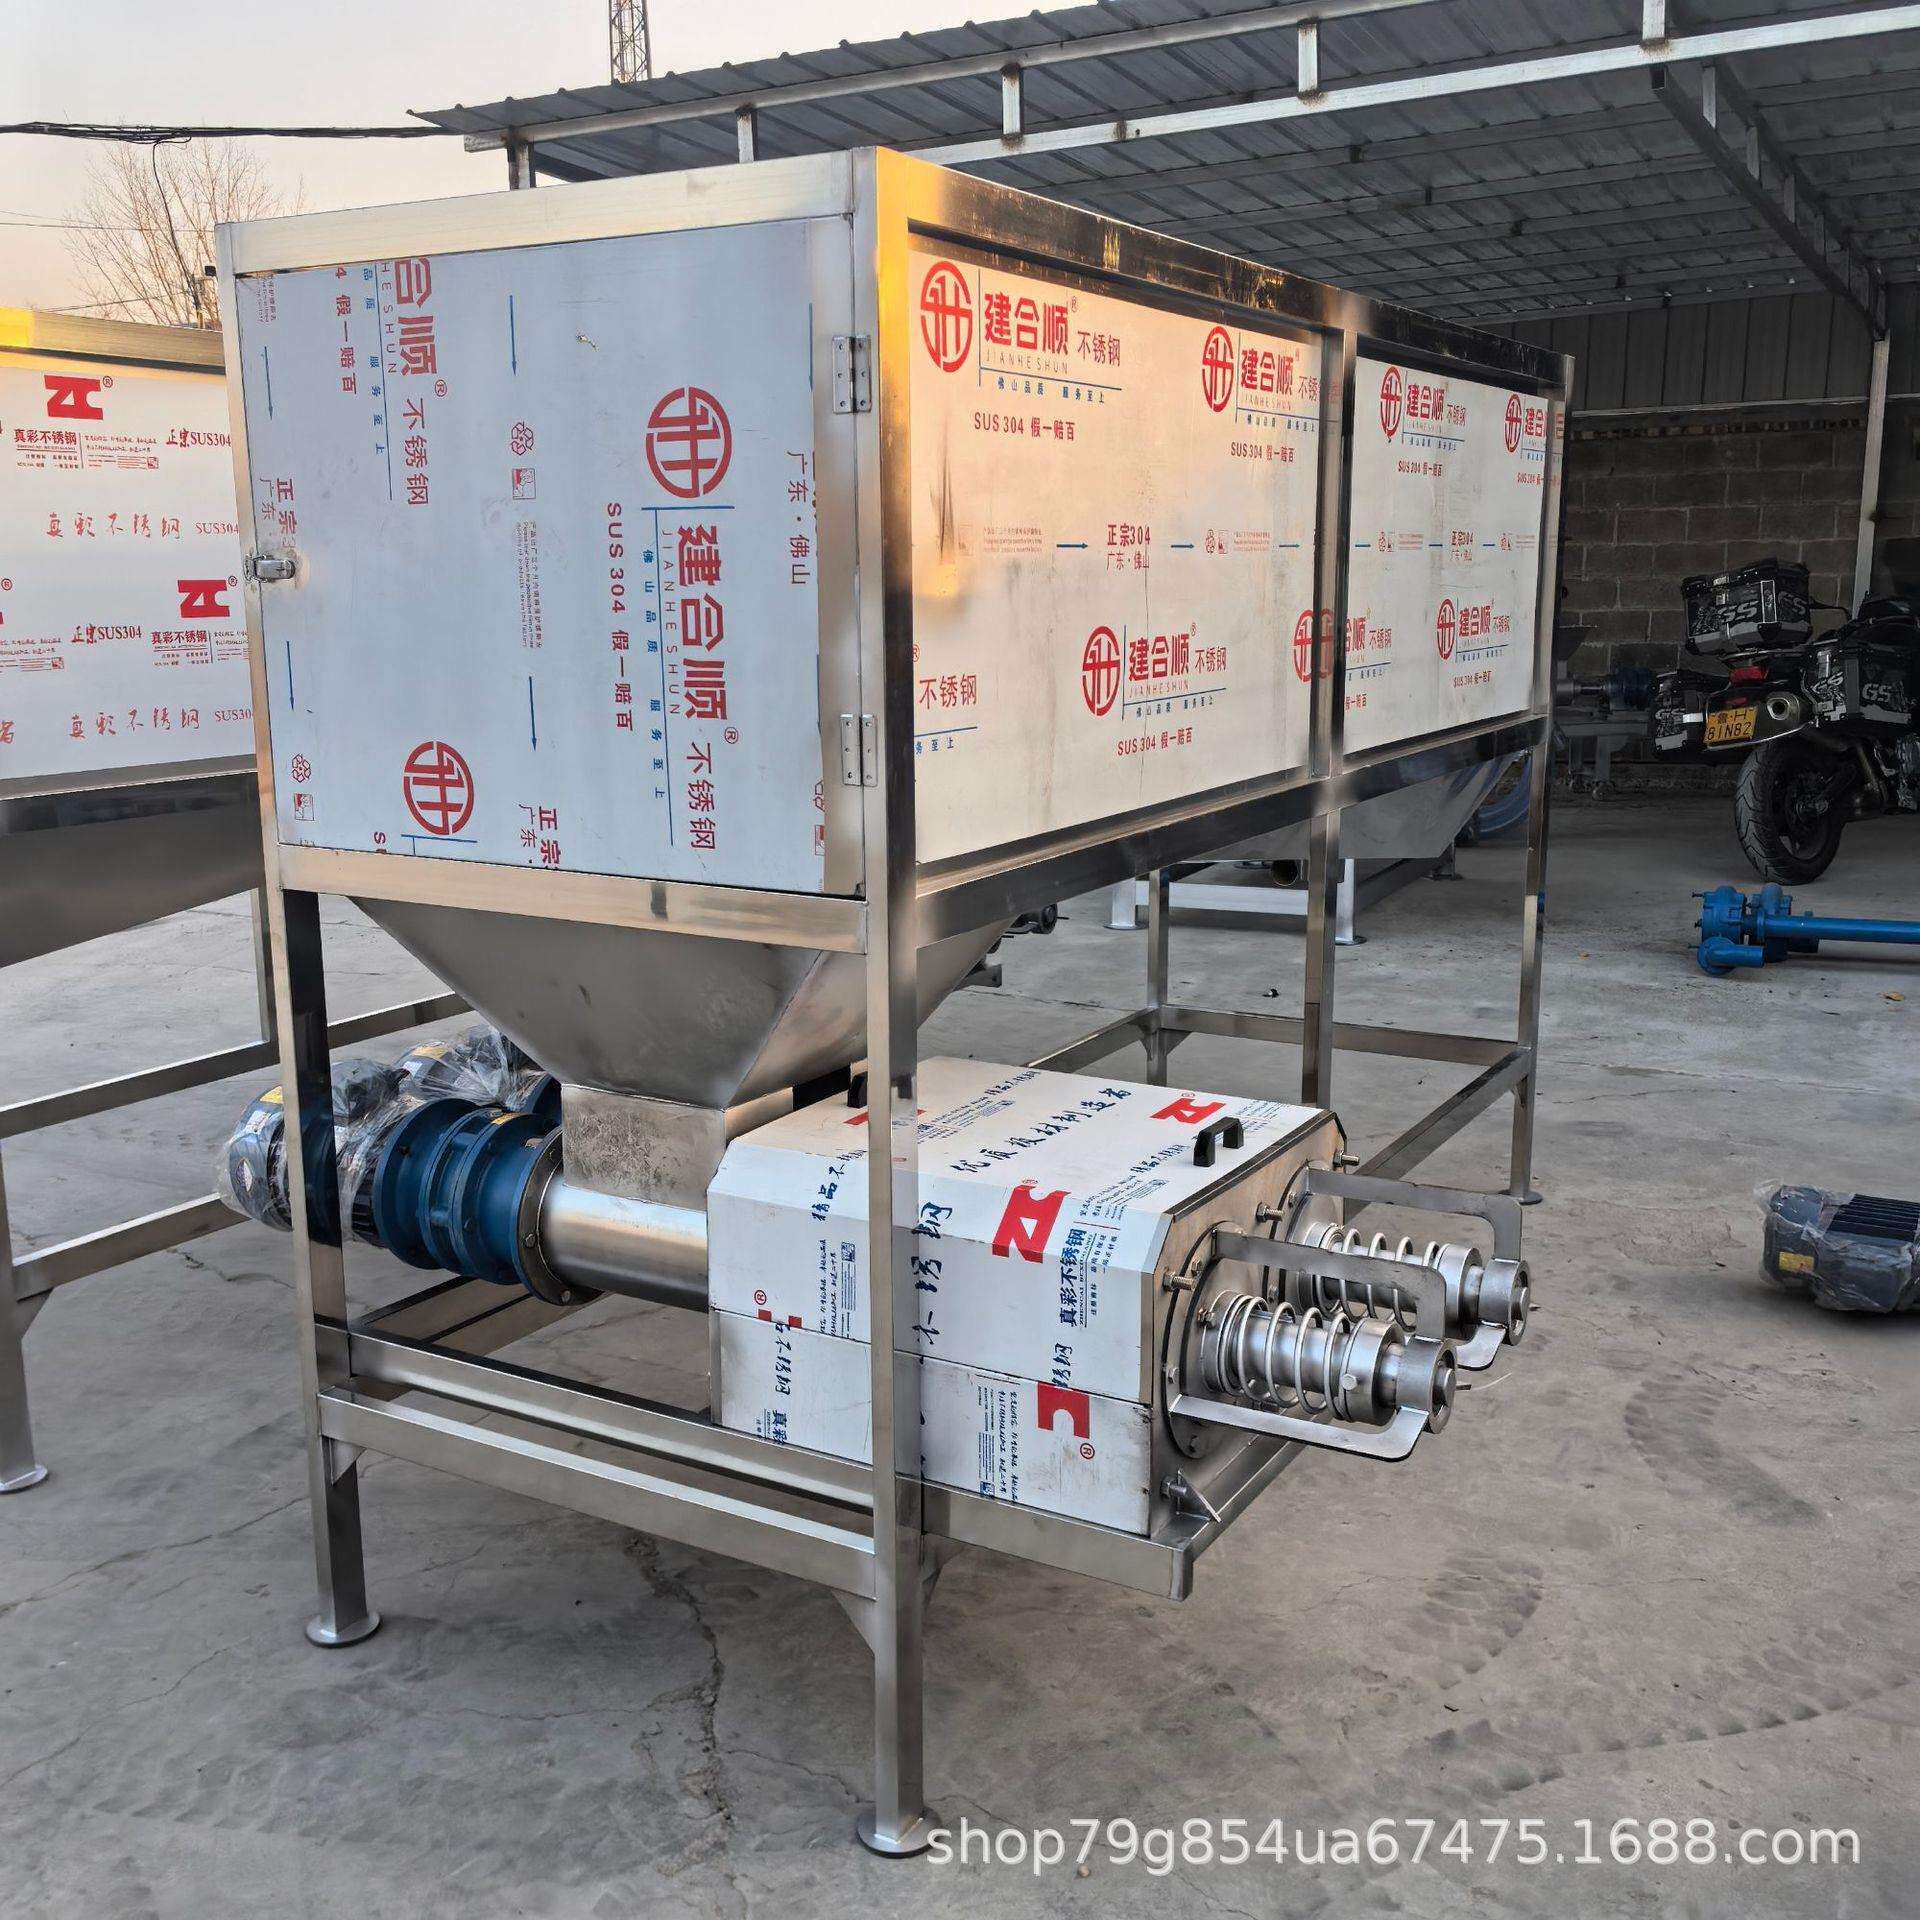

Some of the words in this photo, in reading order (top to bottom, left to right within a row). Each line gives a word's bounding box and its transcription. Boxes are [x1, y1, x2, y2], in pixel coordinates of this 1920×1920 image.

[336, 294, 357, 395] 假一赔百
[984, 291, 1069, 356] 建合顺
[1077, 330, 1121, 367] 不锈钢
[1241, 348, 1294, 396] 建合顺
[14, 429, 77, 446] 真彩不锈钢
[403, 398, 430, 505] 不锈钢
[1031, 416, 1076, 441] 假一赔百
[1107, 522, 1151, 547] 正宗304
[151, 630, 208, 645] 真彩不锈钢
[661, 529, 681, 714] JIANHESHUN
[677, 523, 728, 721] 建合顺
[611, 629, 633, 731] 假一赔百
[1128, 633, 1190, 682] 建合顺
[1194, 645, 1227, 674] 不锈钢
[214, 708, 252, 723] SUS30
[919, 674, 977, 710] 不锈钢
[650, 699, 665, 800] 服务至上
[686, 741, 716, 850] 不锈钢
[539, 806, 561, 867] 正宗
[1058, 1228, 1088, 1328] 真彩不锈钢
